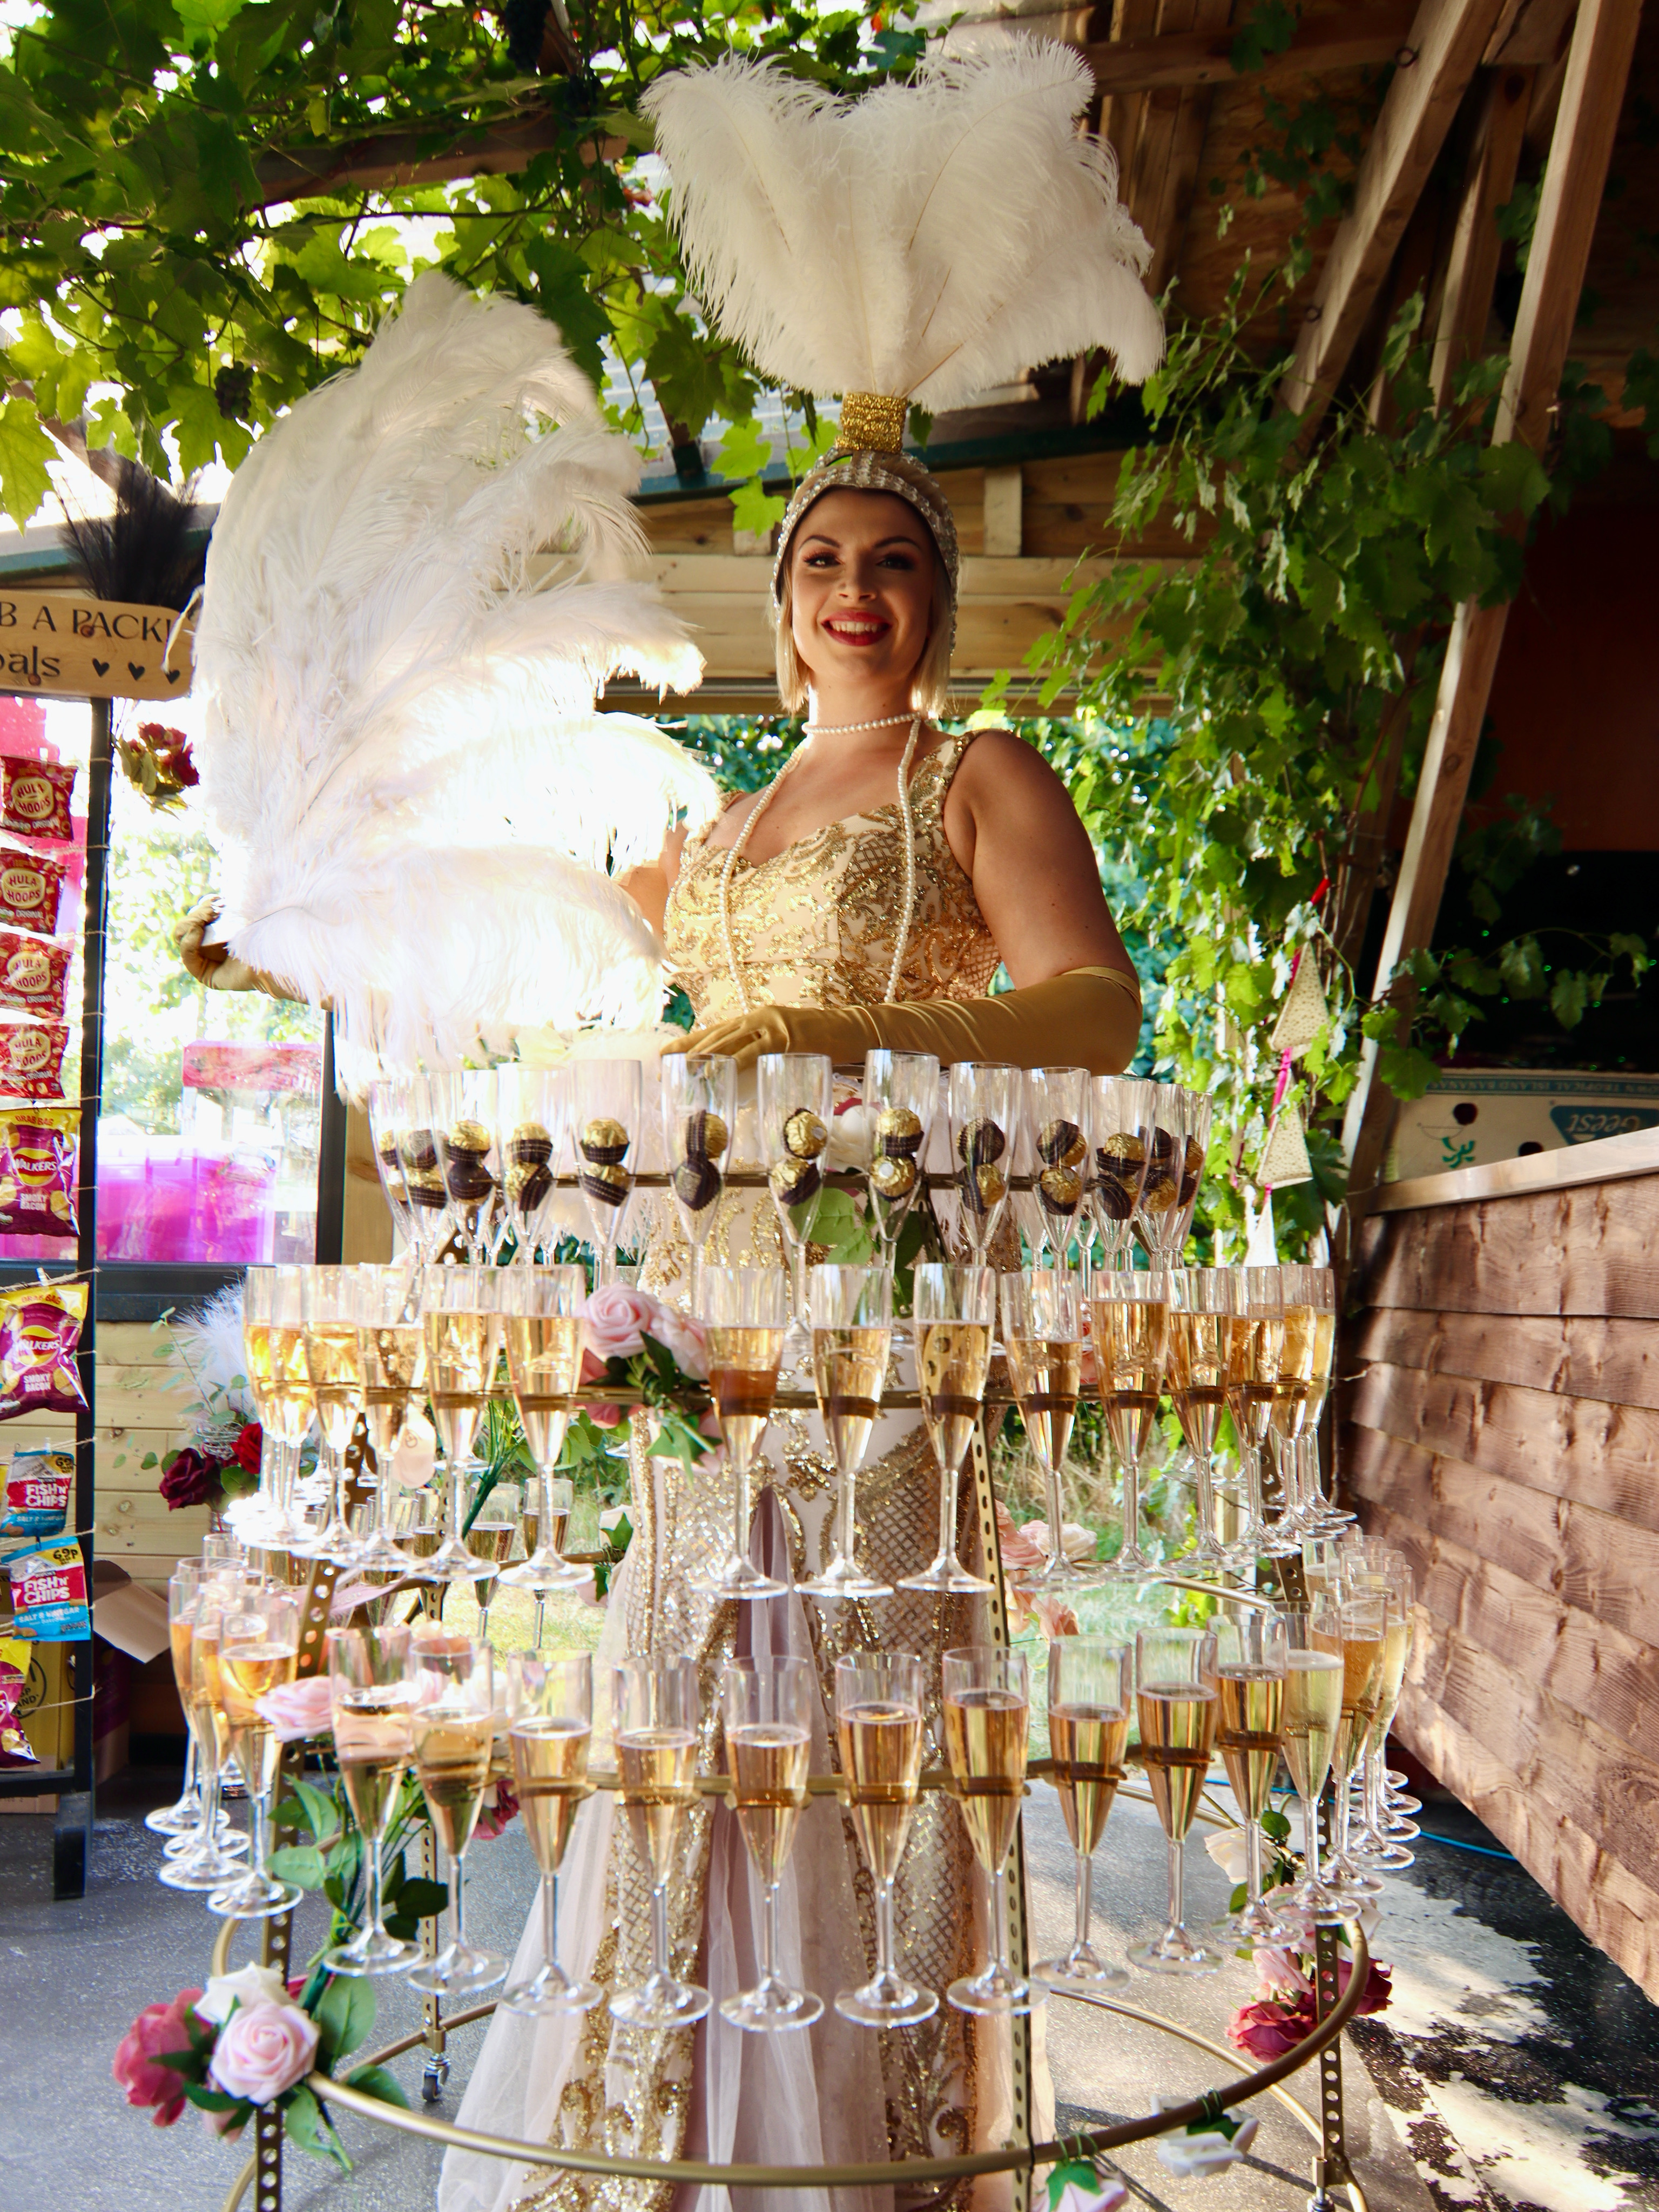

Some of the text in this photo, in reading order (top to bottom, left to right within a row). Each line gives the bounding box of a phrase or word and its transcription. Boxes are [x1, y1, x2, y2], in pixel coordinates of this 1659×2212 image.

[33, 606, 57, 632] A
[18, 795, 51, 813] HOOPS
[9, 875, 37, 886] HULA
[6, 889, 40, 902] HOOPS
[15, 973, 47, 988] HOOPS
[37, 1117, 53, 1126] BAG
[1564, 1113, 1641, 1134] Geest
[15, 1157, 57, 1172] WALKERS
[25, 1494, 68, 1508] CHIPS
[23, 1586, 71, 1604] CHIPS
[18, 1614, 37, 1623] SALT
